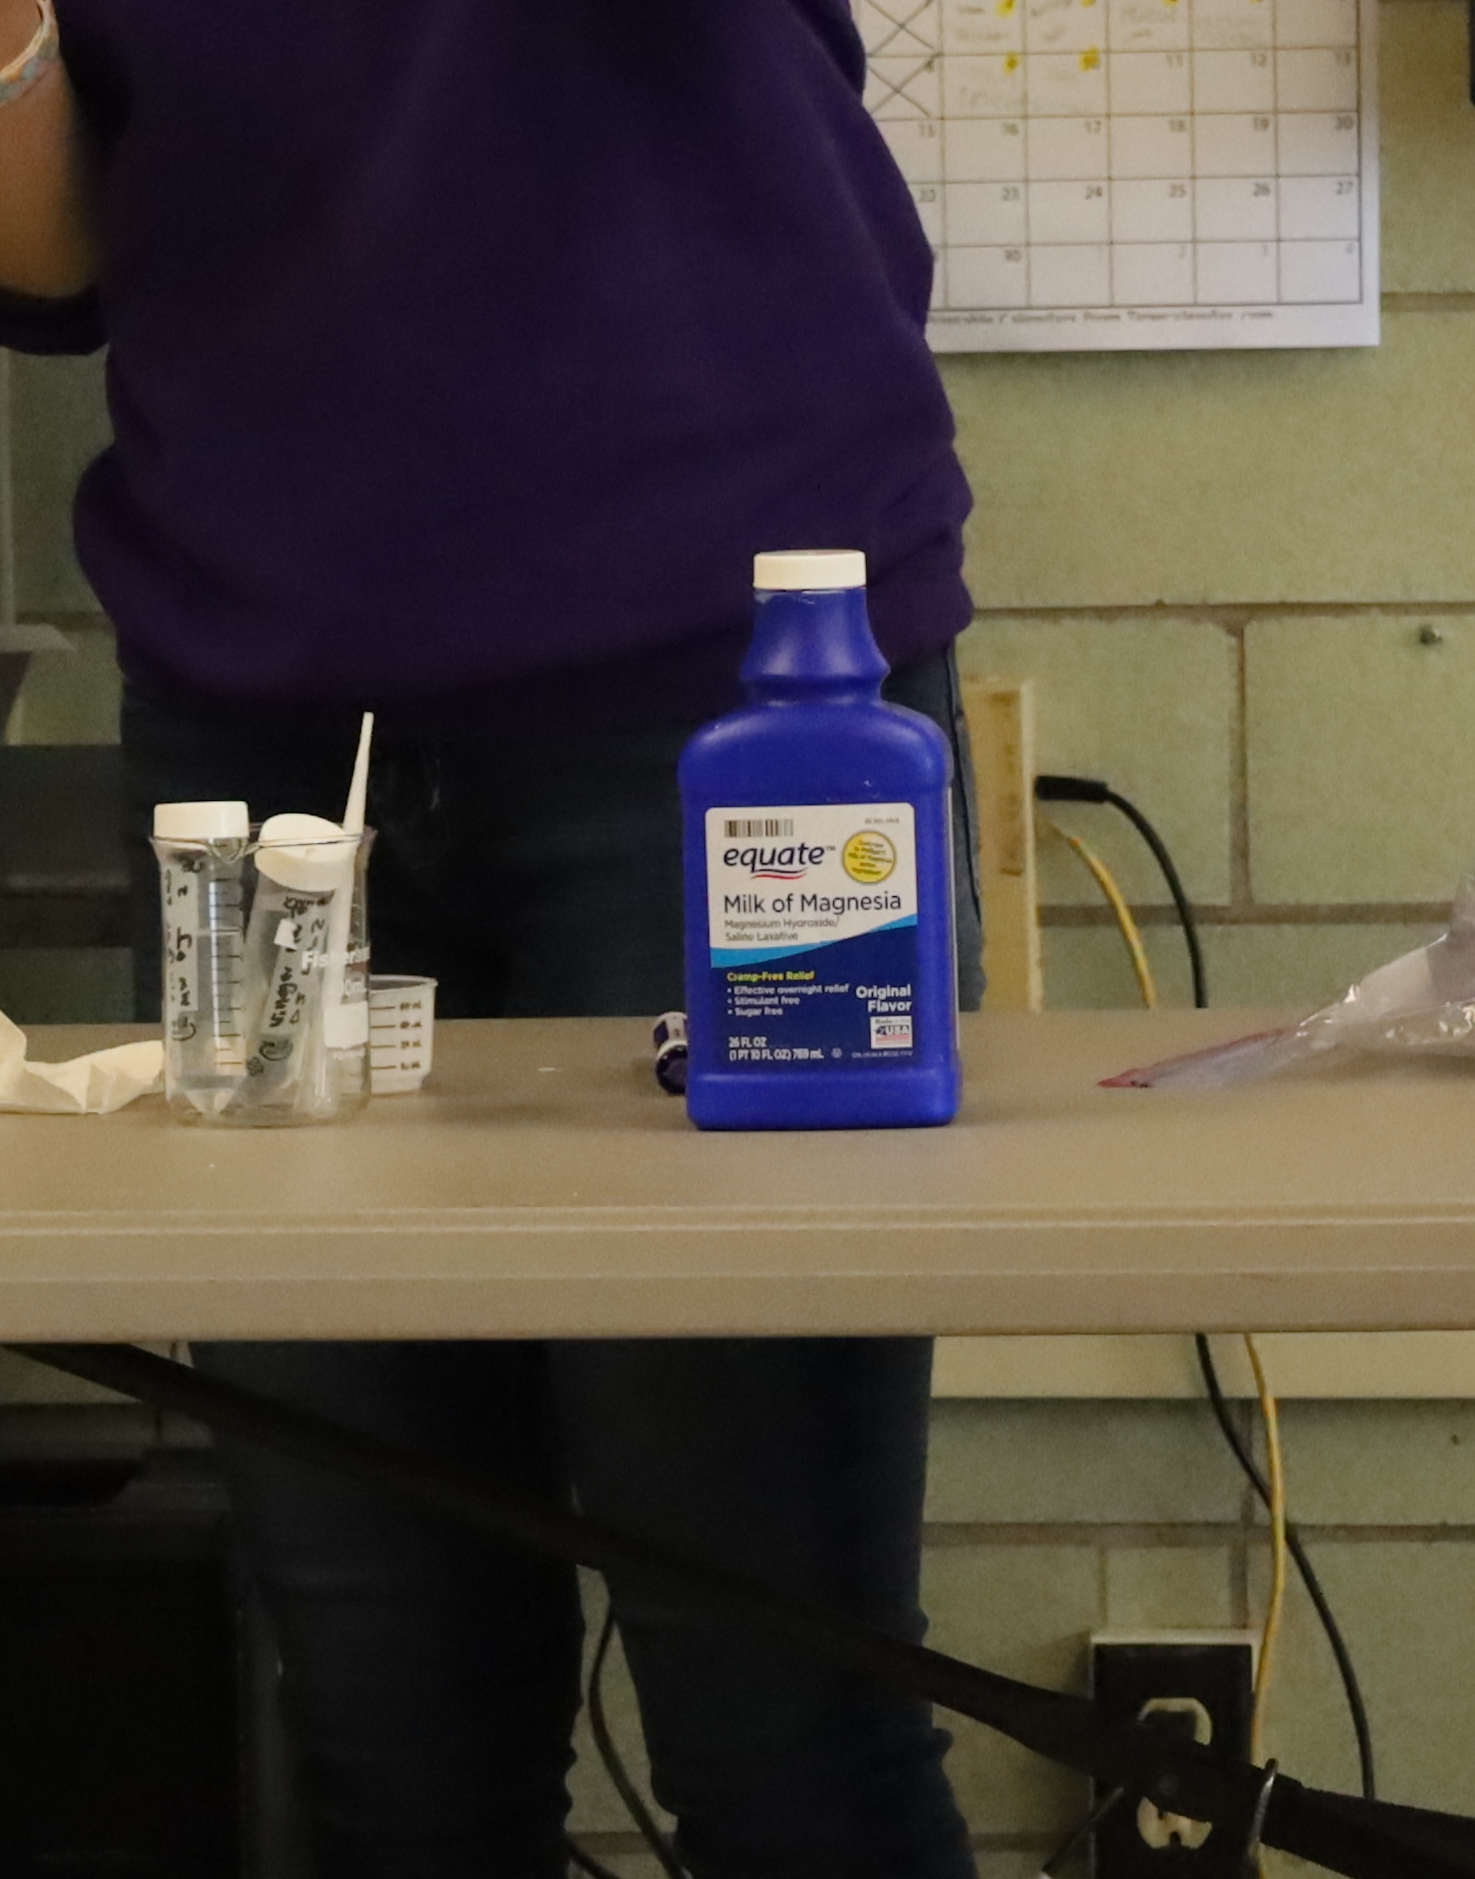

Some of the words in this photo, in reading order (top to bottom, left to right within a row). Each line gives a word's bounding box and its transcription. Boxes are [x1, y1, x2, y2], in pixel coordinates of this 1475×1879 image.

[723, 842, 825, 873] equate
[724, 892, 766, 914] Milk
[772, 892, 794, 913] of
[801, 890, 901, 916] Magnesia
[724, 918, 781, 931] Magnesium
[756, 930, 799, 942] Laxative
[727, 972, 784, 983] Cramp-Free
[786, 970, 815, 981] Relief
[734, 985, 776, 995] Effective
[825, 983, 850, 993] relief
[855, 984, 912, 1000] Original
[781, 995, 800, 1005] free
[867, 999, 912, 1013] Flavor
[734, 1007, 762, 1018] Sugar
[764, 1006, 783, 1016] free
[886, 1025, 910, 1036] USA
